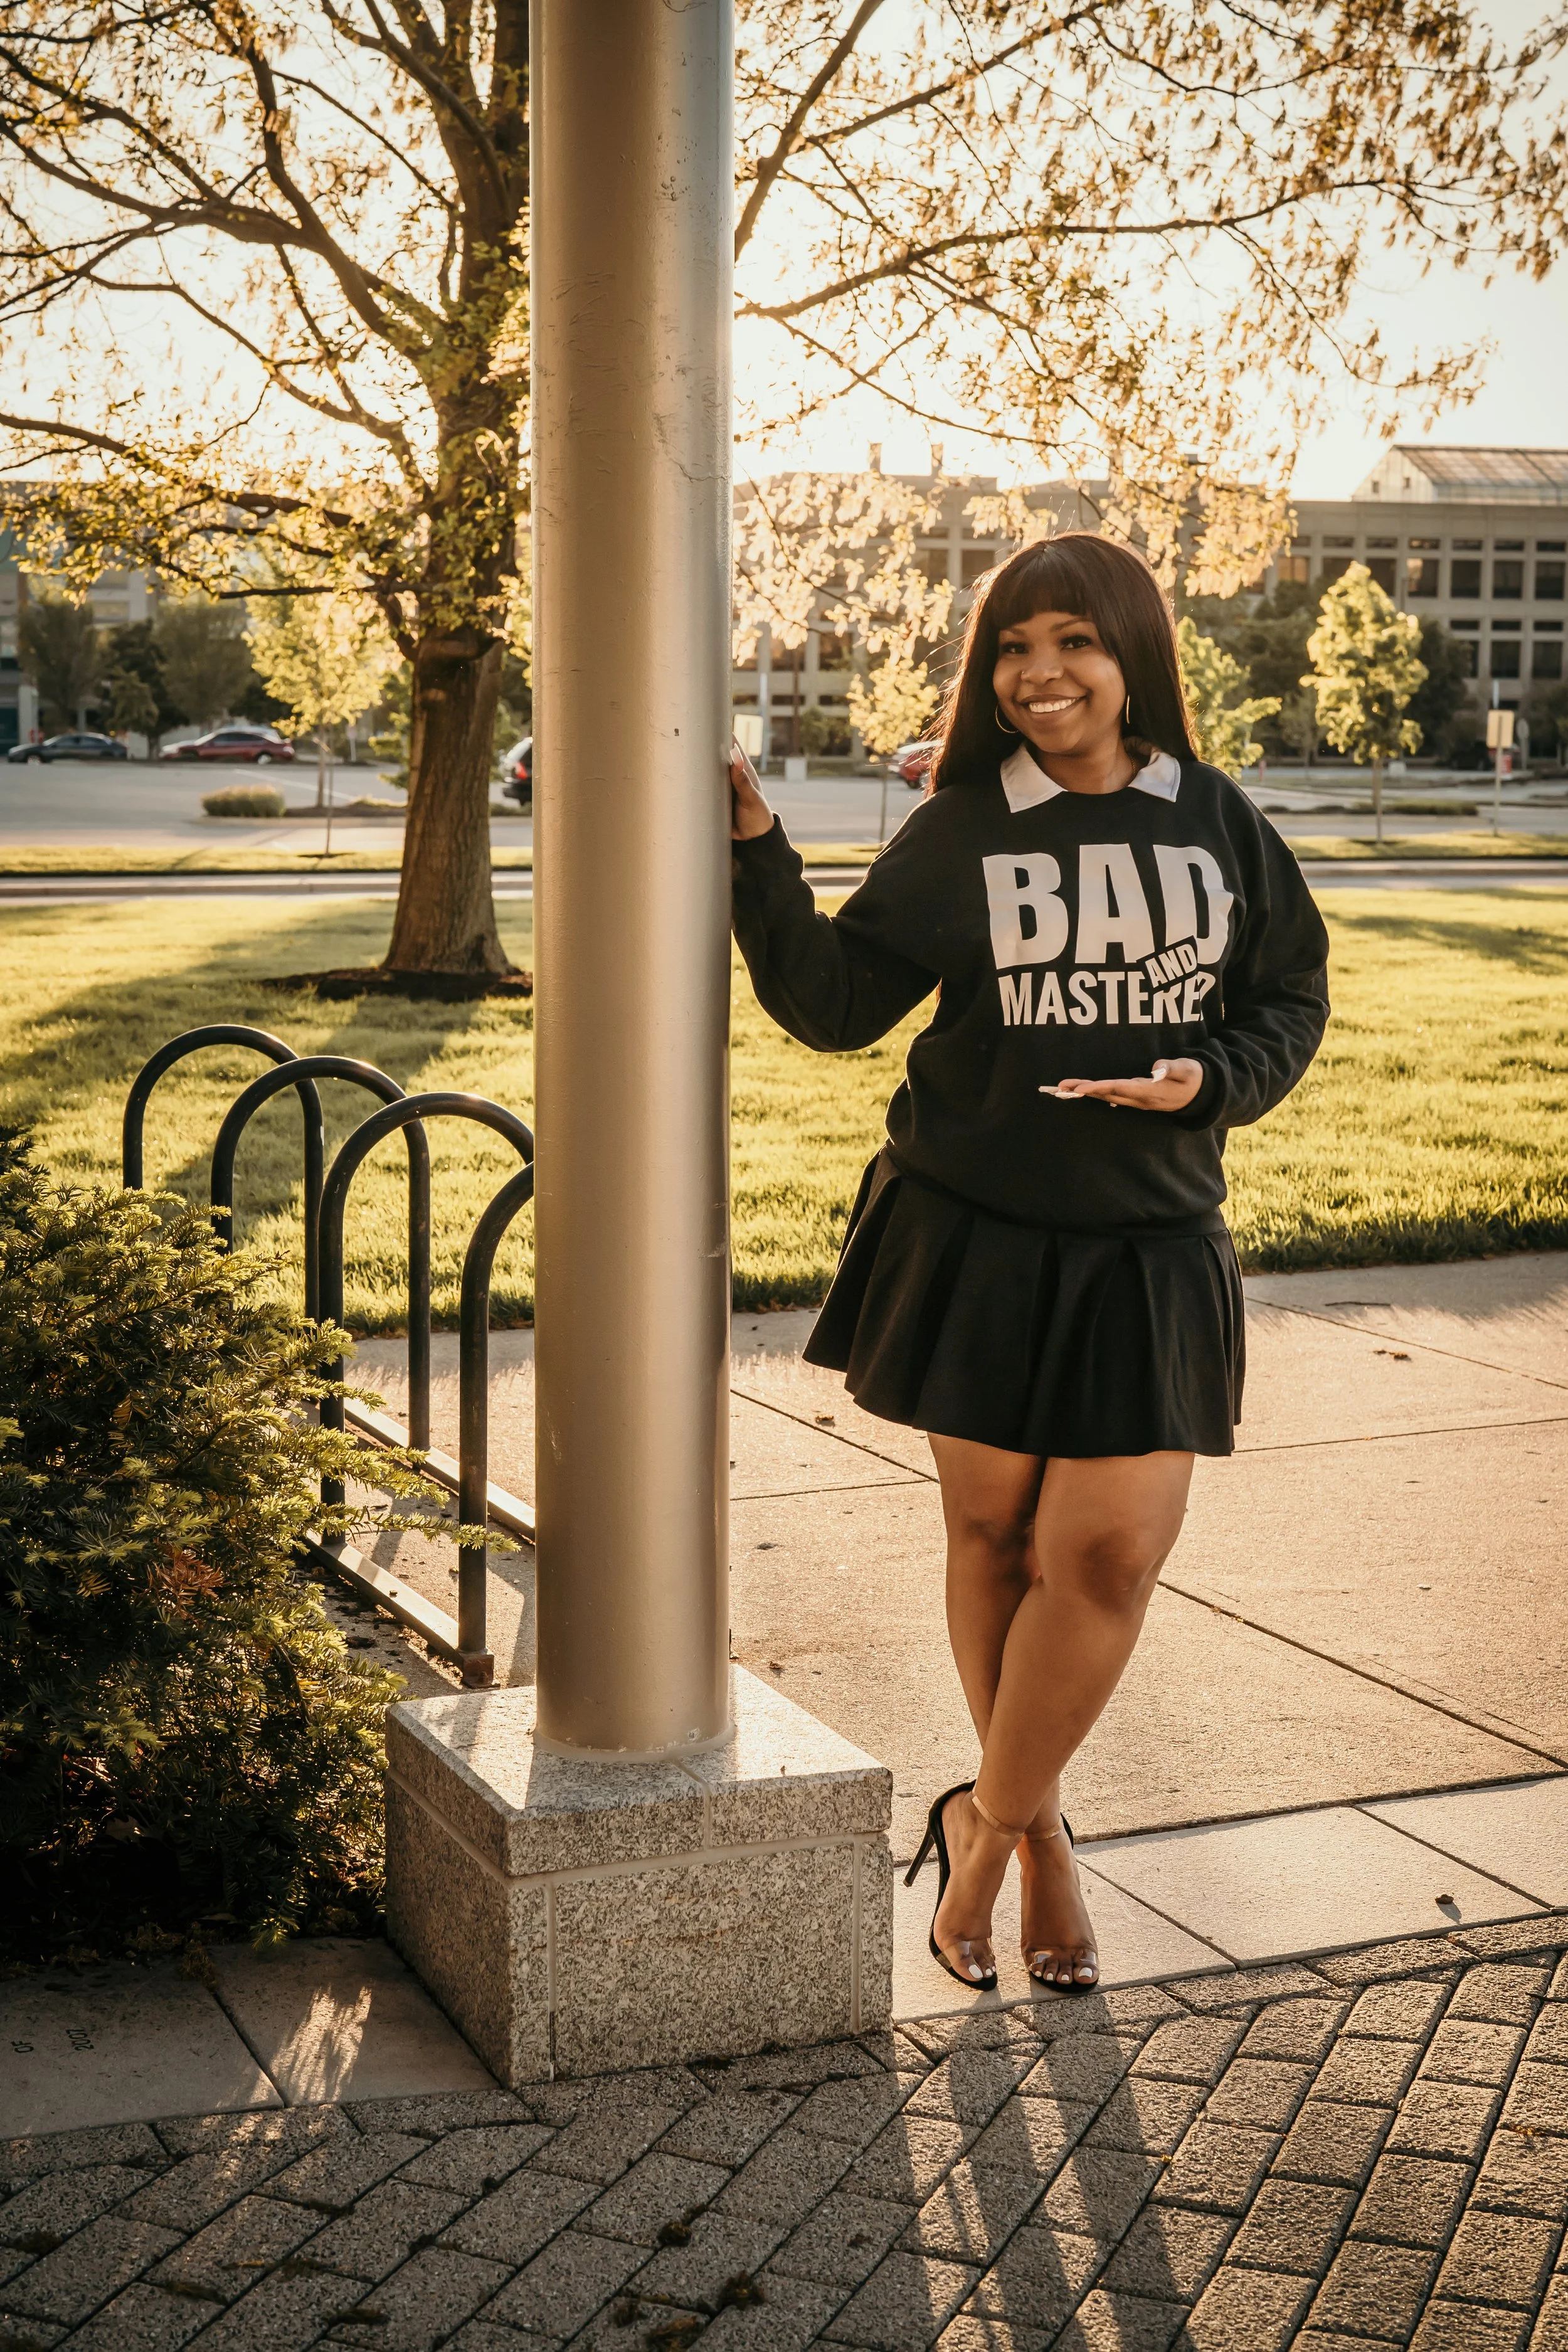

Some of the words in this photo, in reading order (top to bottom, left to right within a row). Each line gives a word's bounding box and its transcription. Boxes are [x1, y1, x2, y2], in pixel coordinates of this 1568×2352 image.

[982, 843, 1234, 970] BAD
[1145, 943, 1197, 988] AND
[11, 2040, 34, 2053] OF
